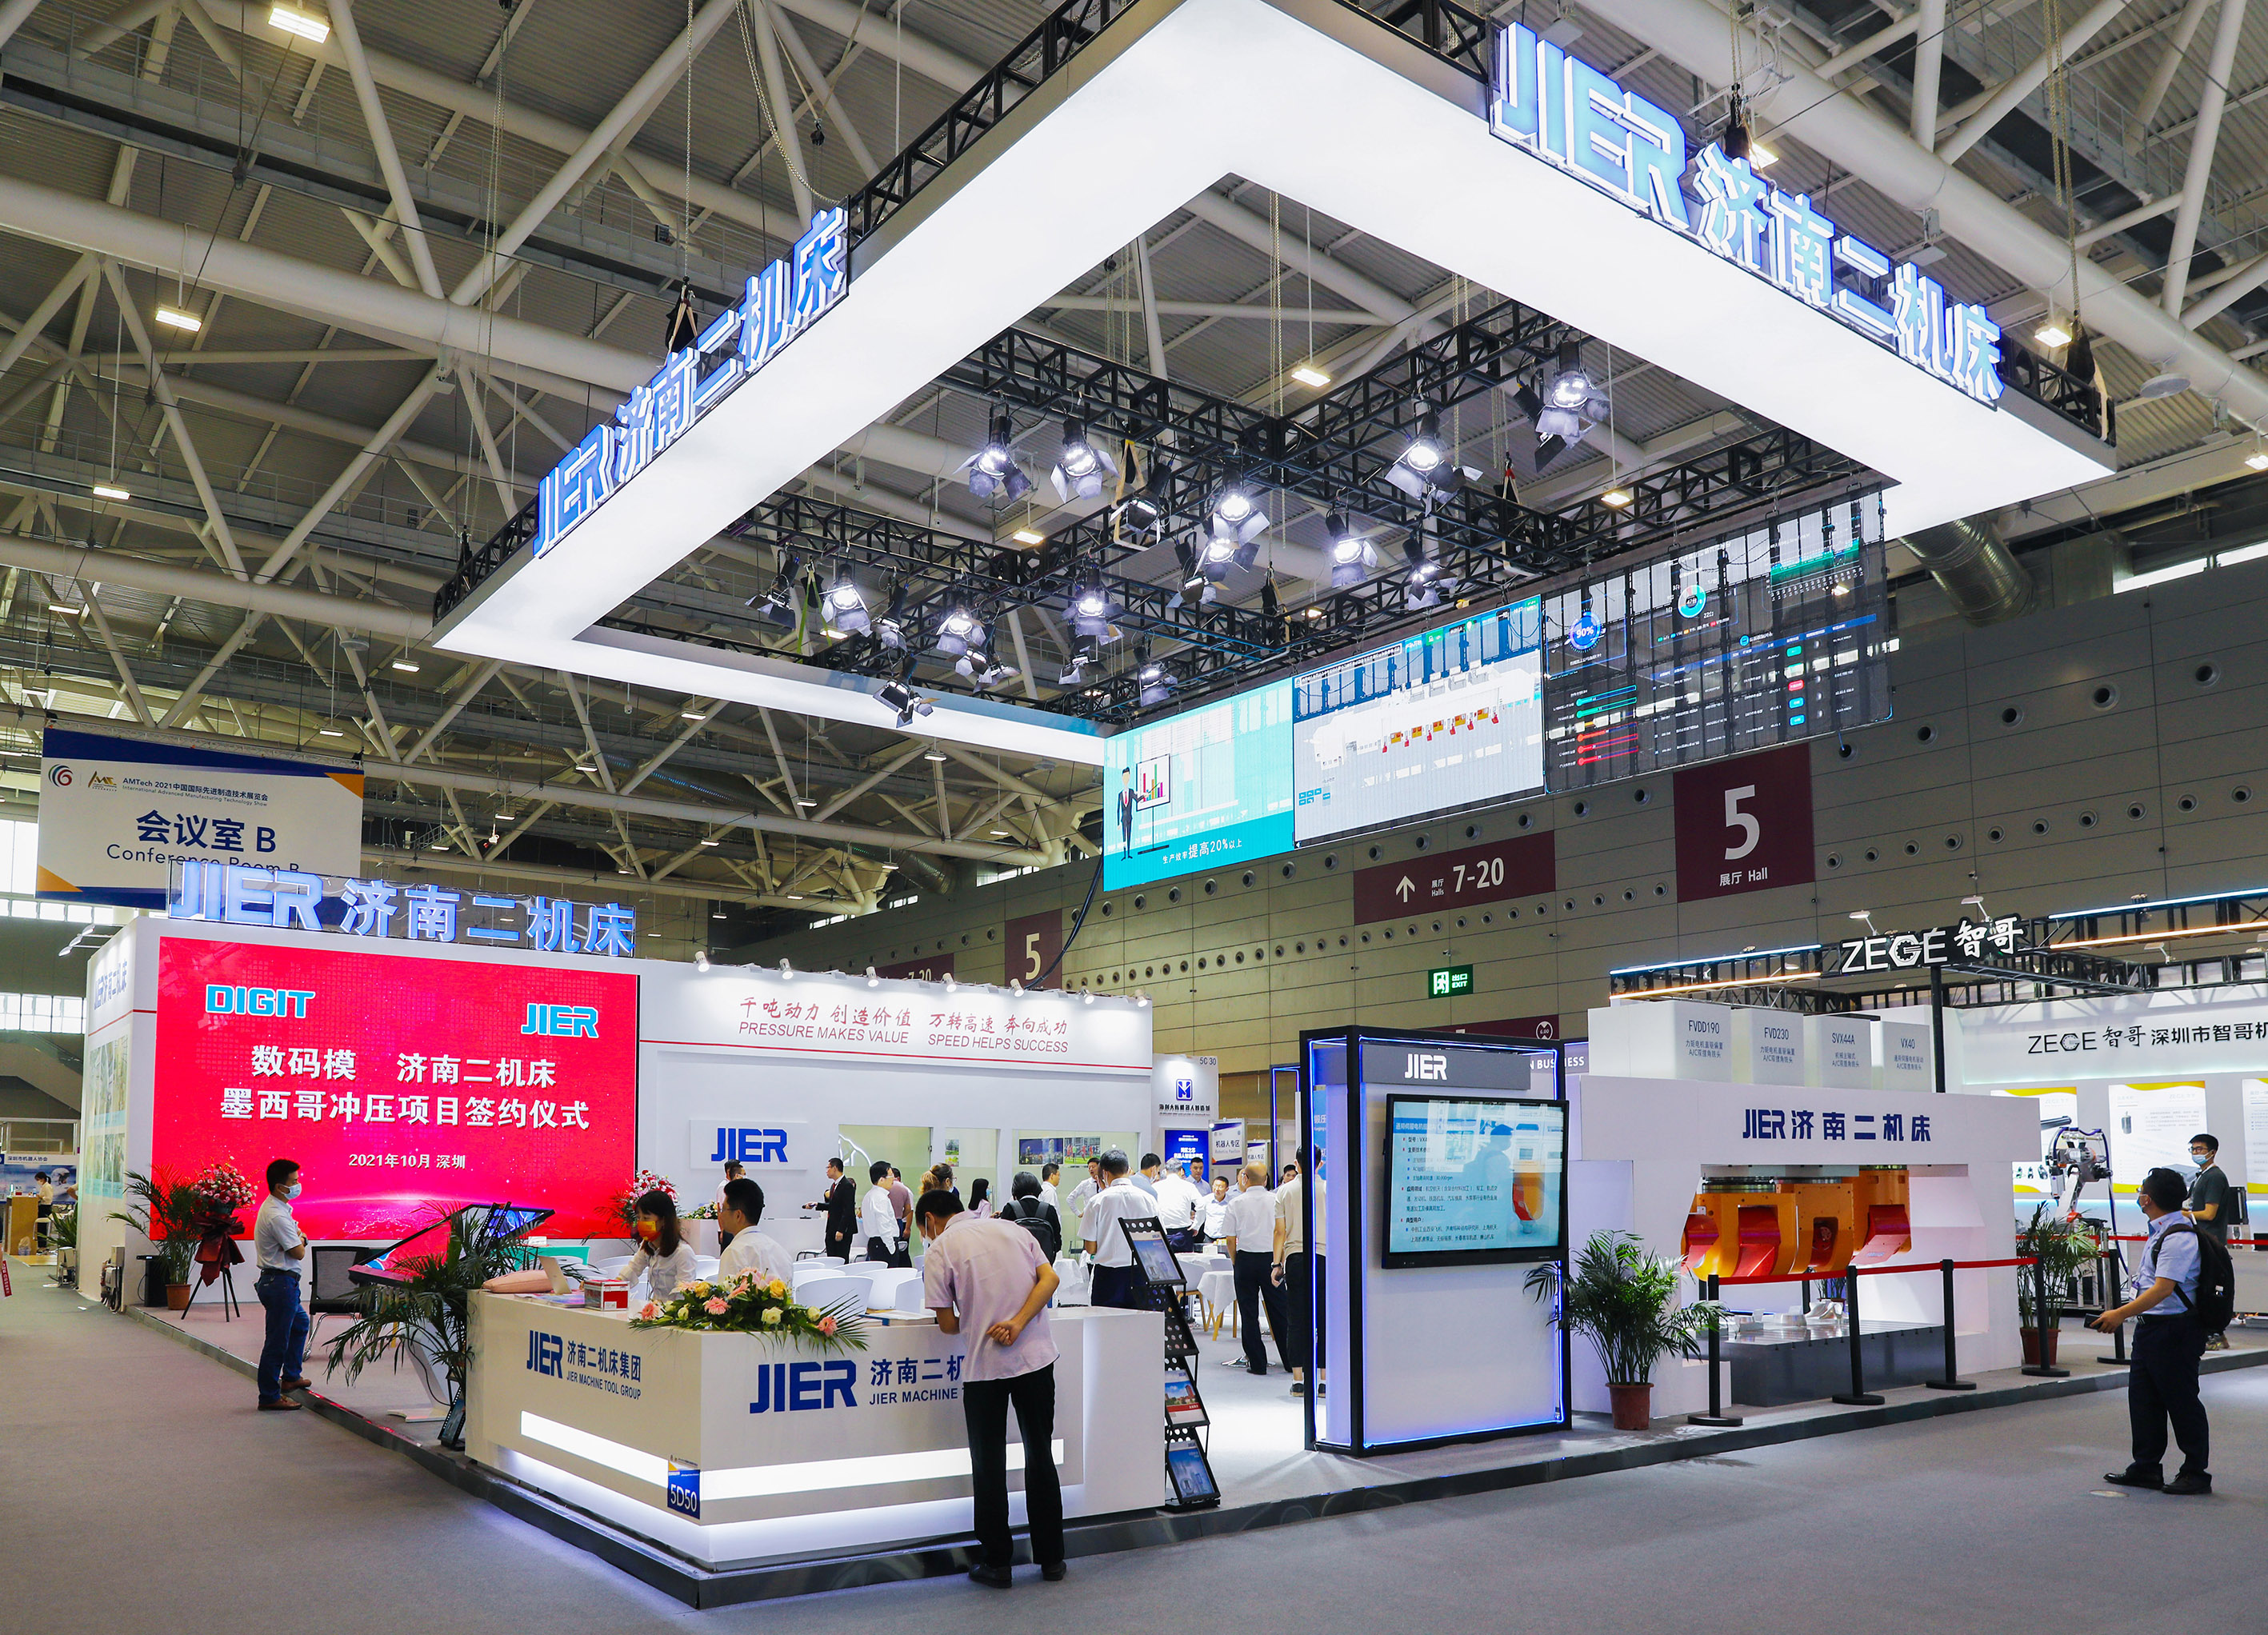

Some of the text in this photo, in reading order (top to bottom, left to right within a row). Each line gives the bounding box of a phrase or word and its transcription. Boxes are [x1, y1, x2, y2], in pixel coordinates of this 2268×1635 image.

[1494, 21, 2006, 403] JIER 济南二机床
[534, 206, 848, 557] JIER 济南二机床
[1576, 626, 1594, 638] 90%
[122, 778, 268, 802] AMTech 2021中国国际先进制造技术展览会
[122, 785, 156, 794] International
[157, 789, 184, 798] Advanced
[185, 791, 222, 803] Manufacturing
[223, 797, 253, 807] Technology
[136, 810, 276, 853] 会议室 B
[1725, 784, 1760, 860] 5
[1431, 857, 1505, 893] 展厅 7-20
[1719, 866, 1768, 886] 展厅 Hall
[170, 861, 636, 957] JIER 济南二机床
[1025, 933, 1042, 981] 5
[1841, 917, 2024, 973] ZEGE 智哥
[1451, 973, 1468, 981] 出口
[1451, 980, 1468, 989] EXIT
[206, 984, 316, 1018] DIGIT
[740, 997, 1067, 1037] 千吨动力 创造价值 万转高速 奔向成功
[521, 1002, 599, 1038] JIER
[1688, 1020, 1720, 1034] FVDD190
[1764, 1026, 1790, 1040] FVD230
[739, 1021, 1069, 1053] PRESSURE MAKES VALUE SPEED HELPS SUCCESS
[1831, 1033, 1855, 1045] SVX44A
[1900, 1037, 1916, 1049] VX40
[2027, 1021, 2268, 1054] ZEGE 智哥 深圳市智哥机
[251, 1044, 557, 1089] 数码模 济南二机床
[1199, 1057, 1217, 1065] 5C 30
[1404, 1053, 1448, 1081] JIER
[220, 1087, 590, 1130] 墨西哥冲压项目签约仪式
[1742, 1109, 1931, 1142] JIER 济南二机床
[710, 1127, 788, 1163] JIER
[1215, 1139, 1240, 1148] 机器人专区
[349, 1153, 466, 1169] 2021年10月 深圳
[526, 1329, 641, 1383] JIER 济南二机床集团
[566, 1370, 641, 1400] JIER MACHINE TOOL GROUP
[749, 1360, 858, 1414] JIER
[869, 1387, 958, 1405] JIER MACHINE
[670, 1483, 698, 1513] 5D50
